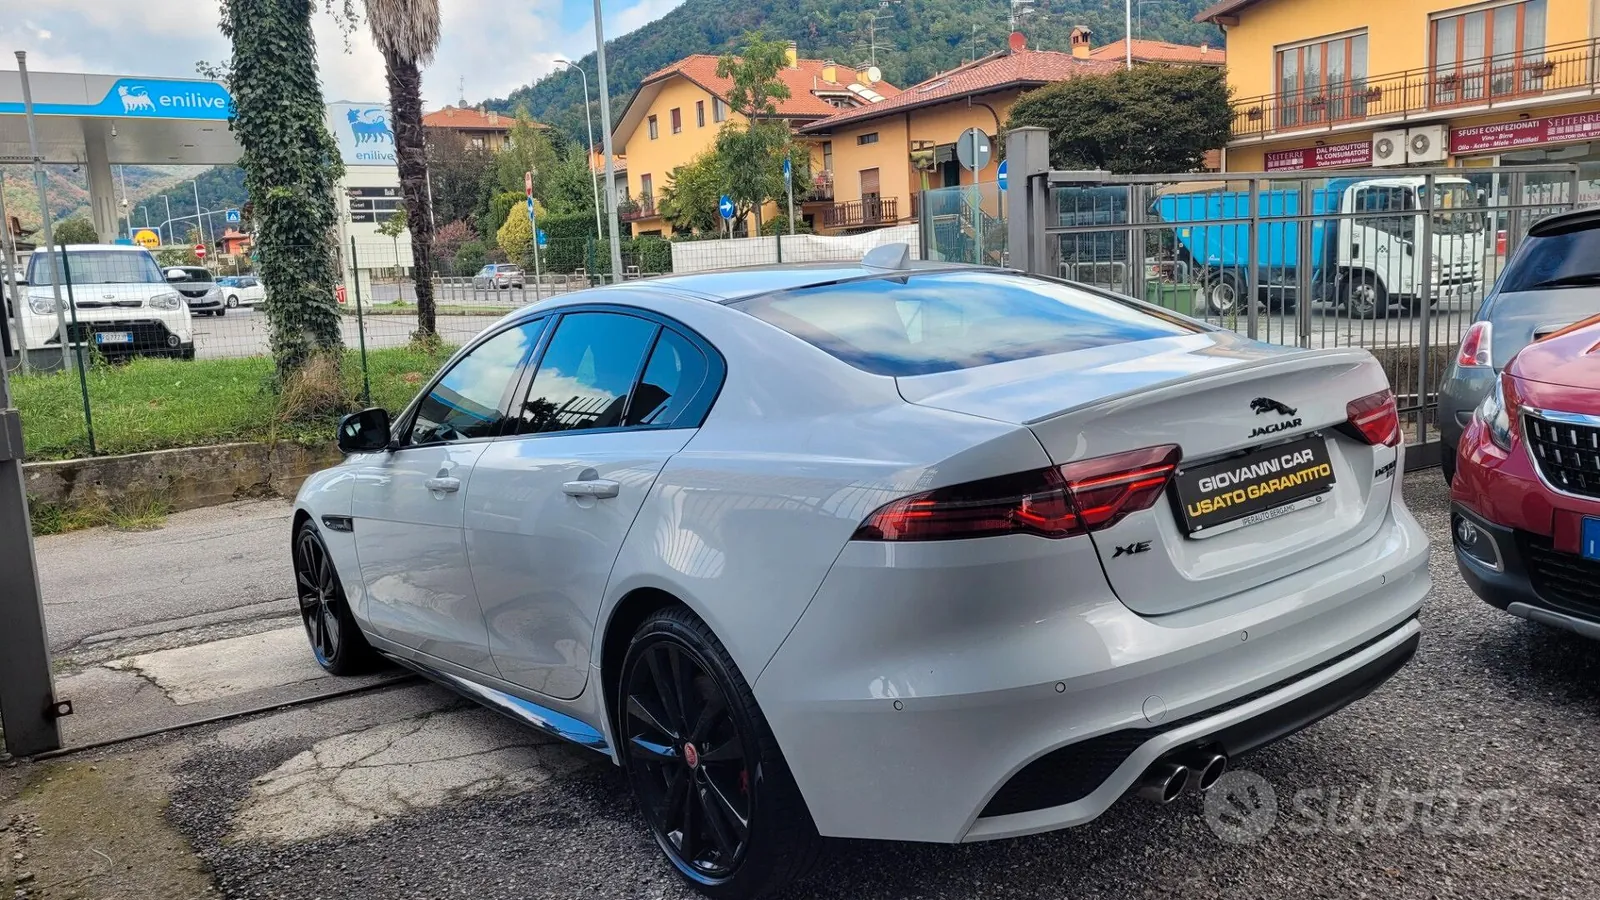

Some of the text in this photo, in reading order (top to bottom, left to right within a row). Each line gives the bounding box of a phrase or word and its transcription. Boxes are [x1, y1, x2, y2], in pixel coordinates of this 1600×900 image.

[159, 92, 225, 109] enilive
[1547, 113, 1600, 128] SEITERRE
[1458, 128, 1479, 137] SFUSI
[1485, 121, 1540, 134] CONFEZIONATI
[1329, 142, 1370, 151] PRODUTTORE
[1513, 136, 1540, 145] Distillati
[355, 150, 394, 160] enilive
[1267, 151, 1304, 161] SEITERRE
[1324, 149, 1370, 159] CONSUMATORE
[1247, 418, 1303, 438] JAGUAR
[1198, 448, 1315, 493] GIOVANNI CAR
[1188, 463, 1332, 518] USATO GARANTITO
[1242, 504, 1296, 525] IPERAUTO BERGAMO
[1111, 539, 1153, 559] XE
